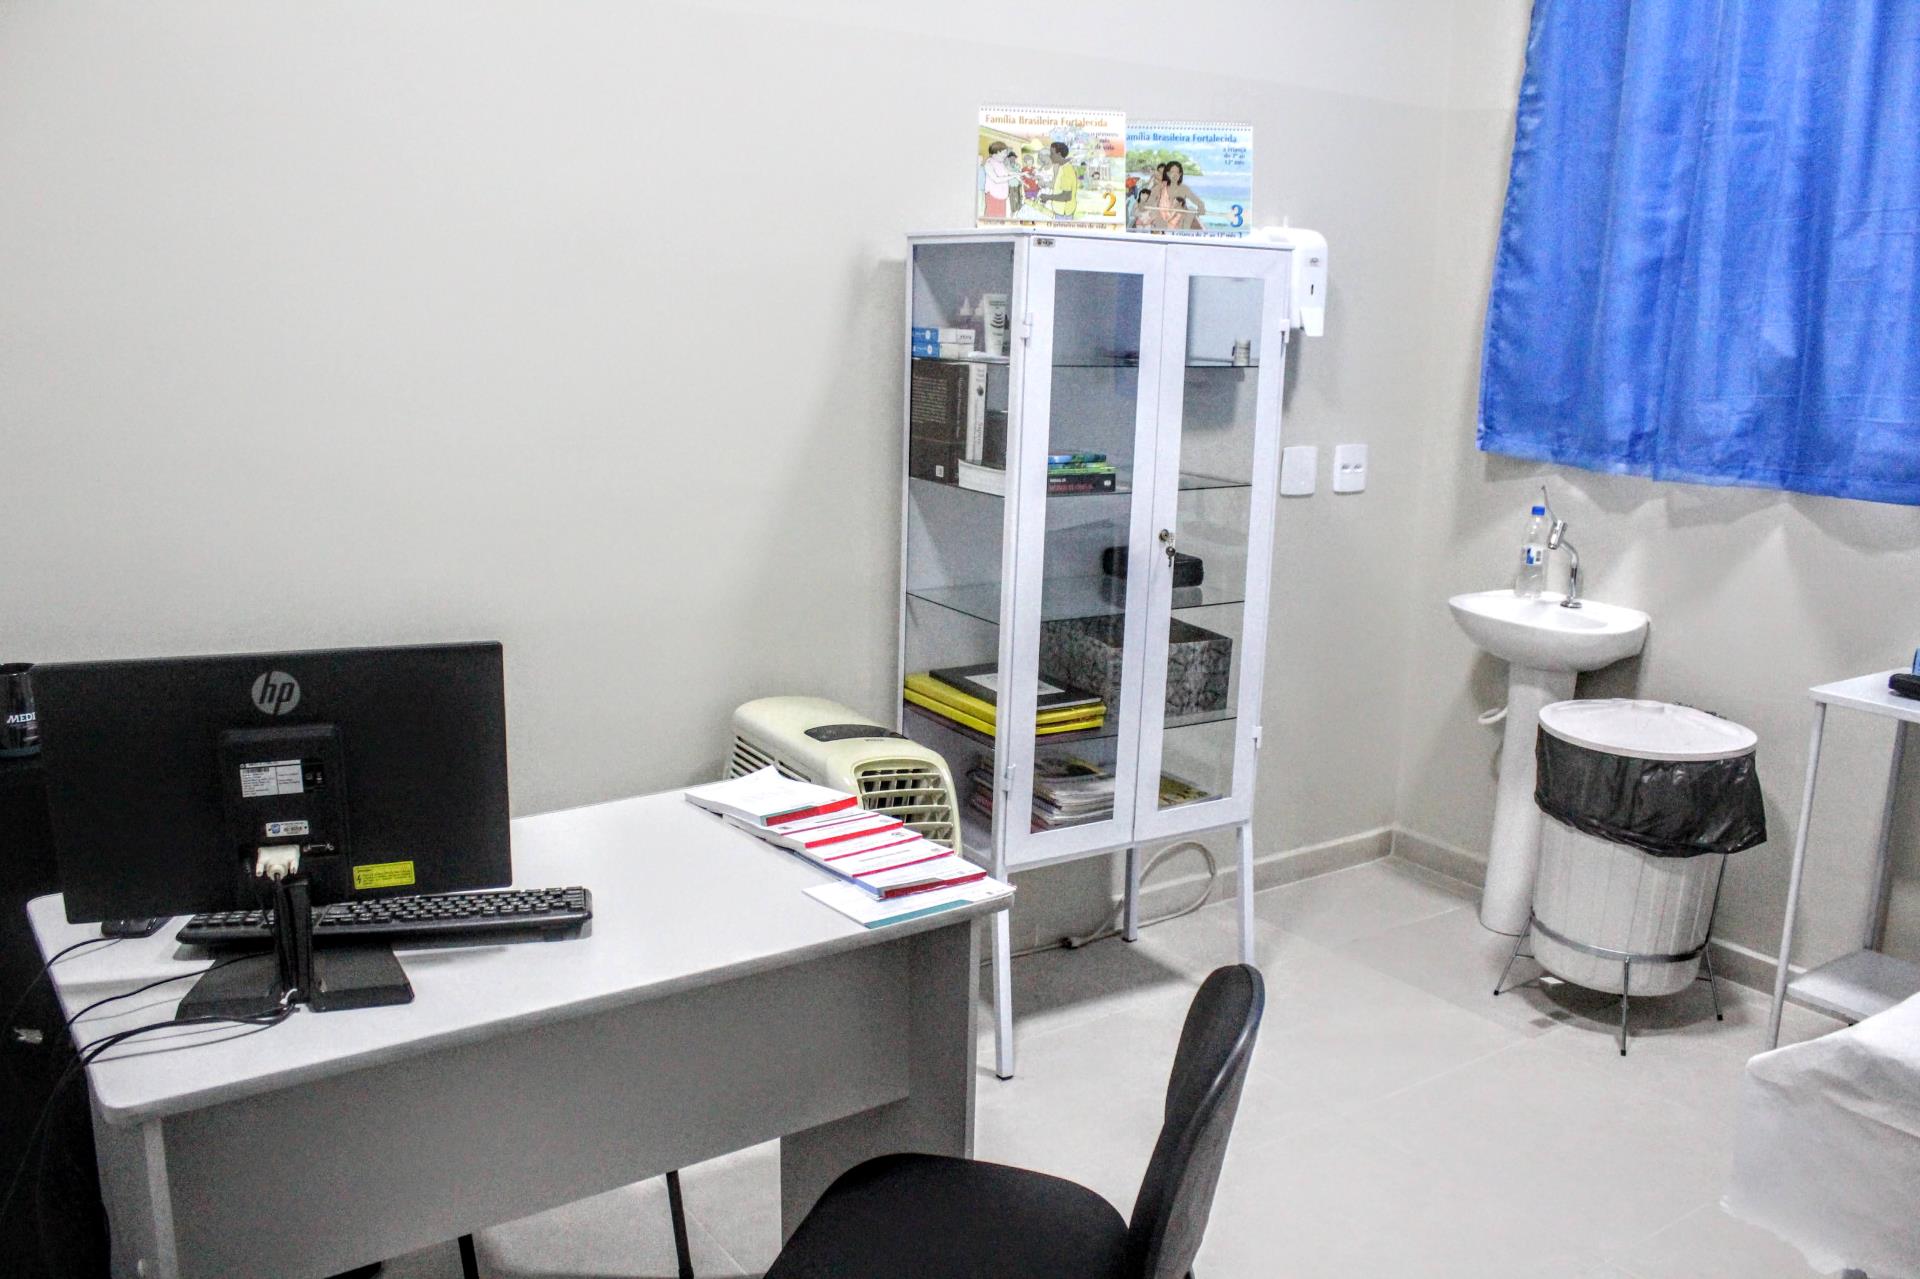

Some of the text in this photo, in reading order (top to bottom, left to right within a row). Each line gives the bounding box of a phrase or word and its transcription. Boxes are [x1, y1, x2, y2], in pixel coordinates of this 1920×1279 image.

[985, 114, 1108, 128] Família Brasileira Fortalecida
[1126, 131, 1238, 143] amília Brasileira Fortalecida
[1102, 191, 1117, 217] 2
[1230, 204, 1244, 228] 3
[259, 670, 295, 715] hp
